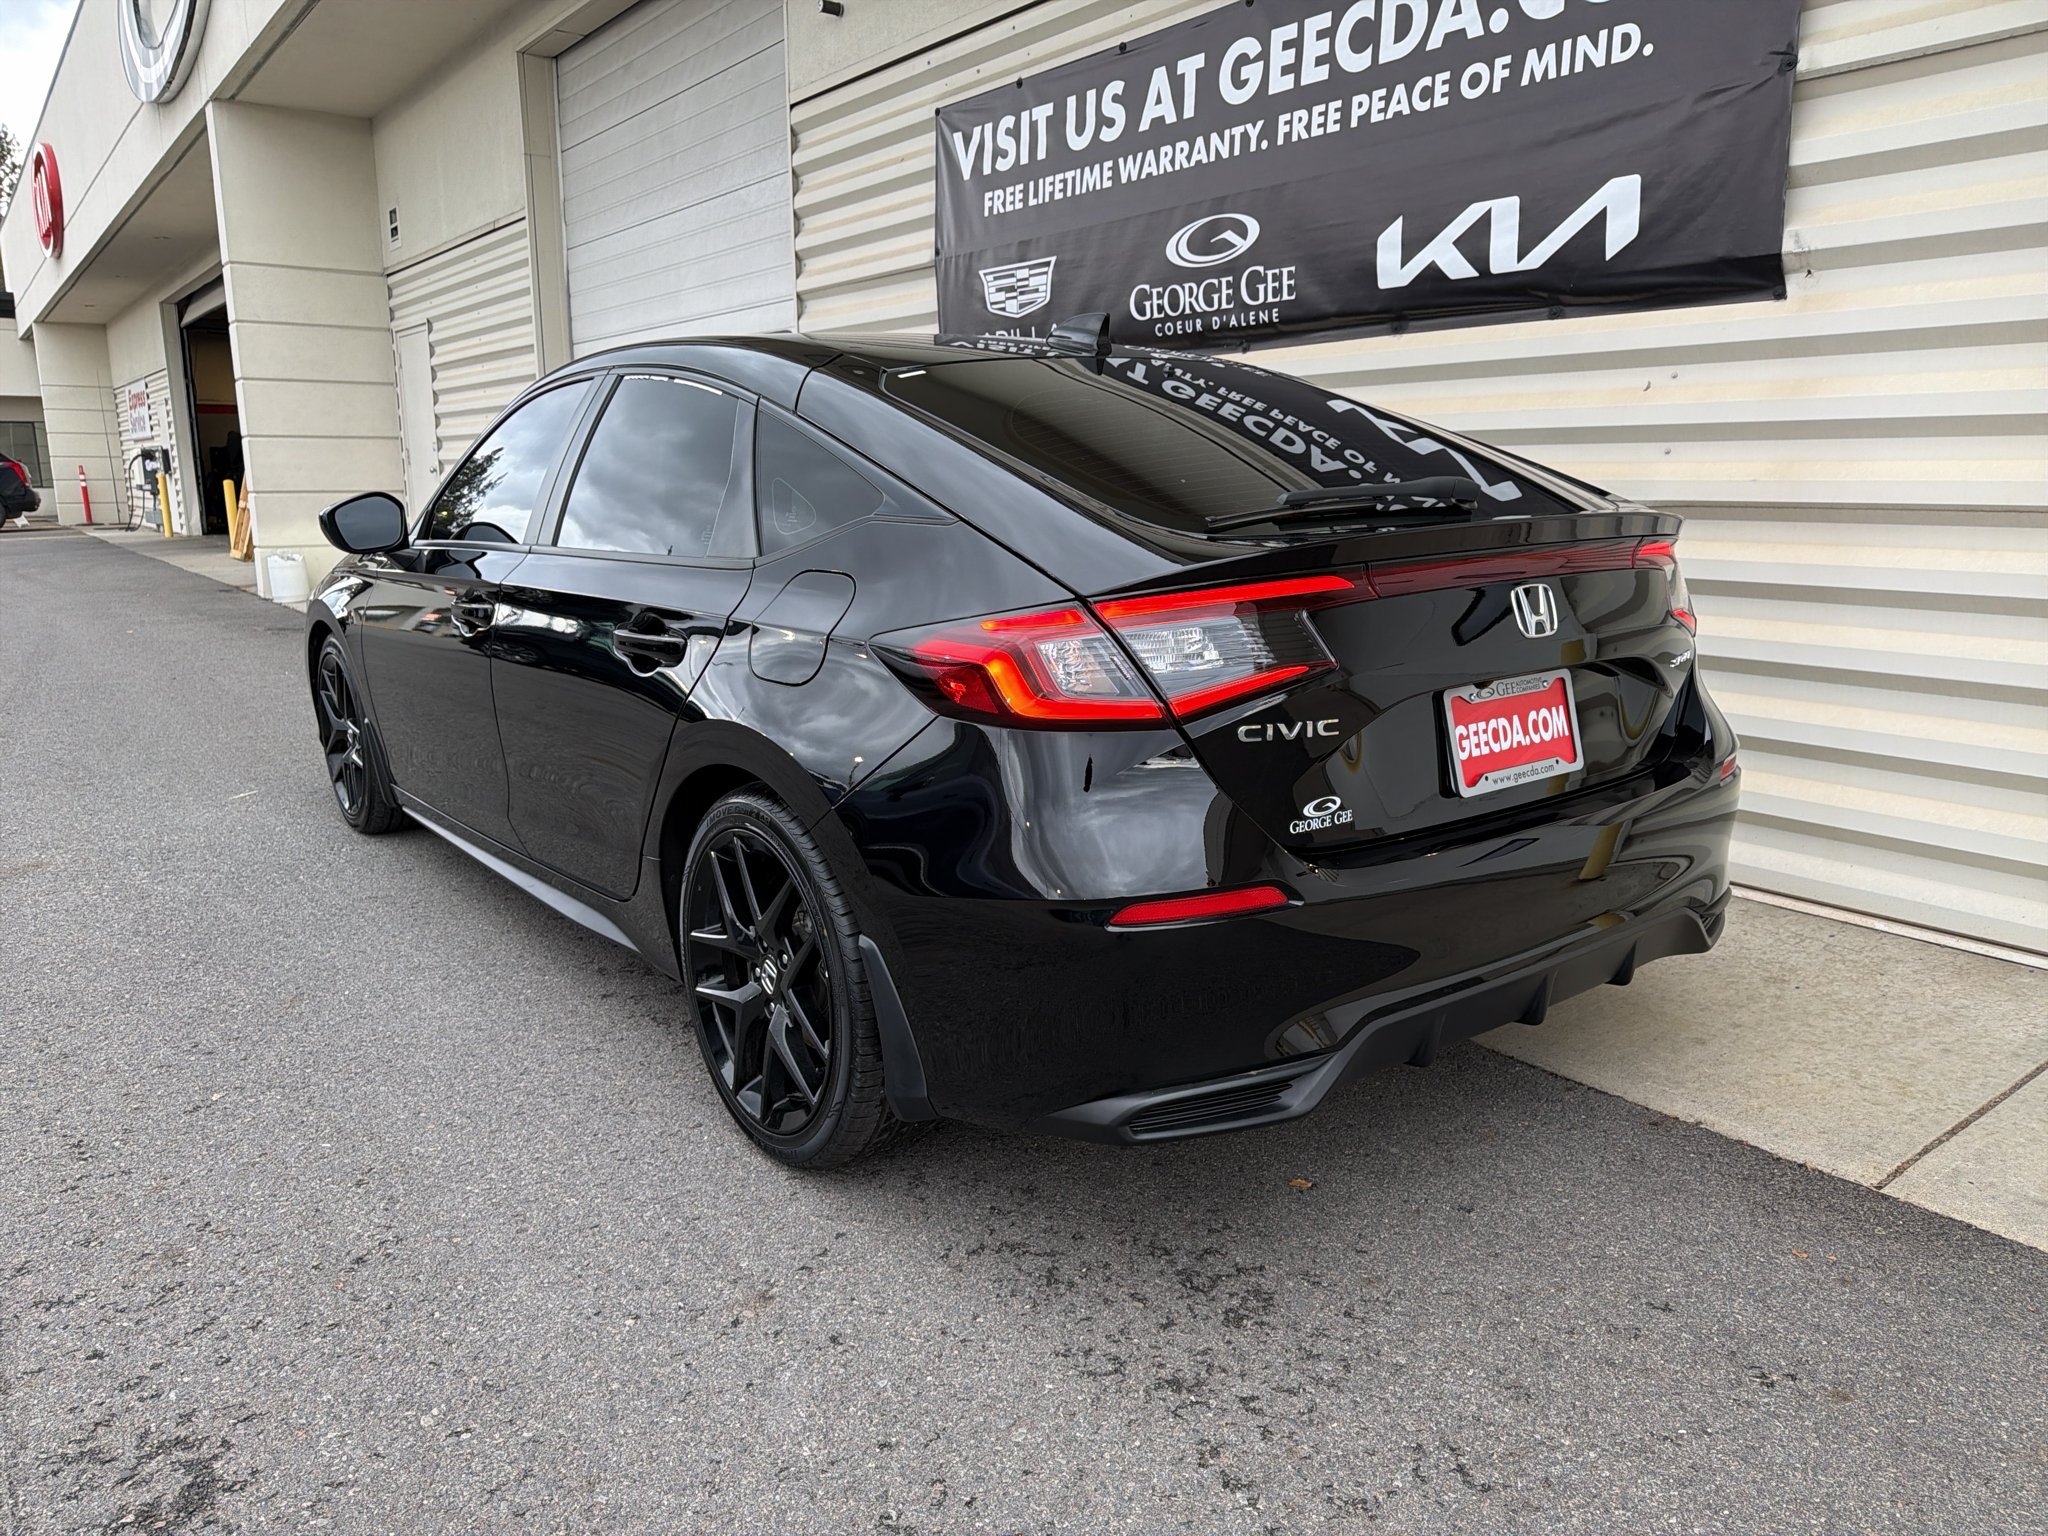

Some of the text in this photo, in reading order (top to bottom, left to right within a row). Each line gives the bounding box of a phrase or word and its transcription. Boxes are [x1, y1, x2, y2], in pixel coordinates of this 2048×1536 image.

[953, 0, 1612, 181] VISIT US AT GEECDA.
[983, 22, 1654, 217] FREE LIFETIME WARRANTY. FREE PEACE OF MIND.
[1129, 265, 1297, 322] GEORGE GEE
[1154, 307, 1280, 337] COEUR D'ALENE
[1237, 718, 1340, 742] CIVIC
[1454, 704, 1569, 760] GEECDA.COM
[1491, 763, 1555, 785] www.geecda.com
[1289, 809, 1353, 834] GEORGE GEE
